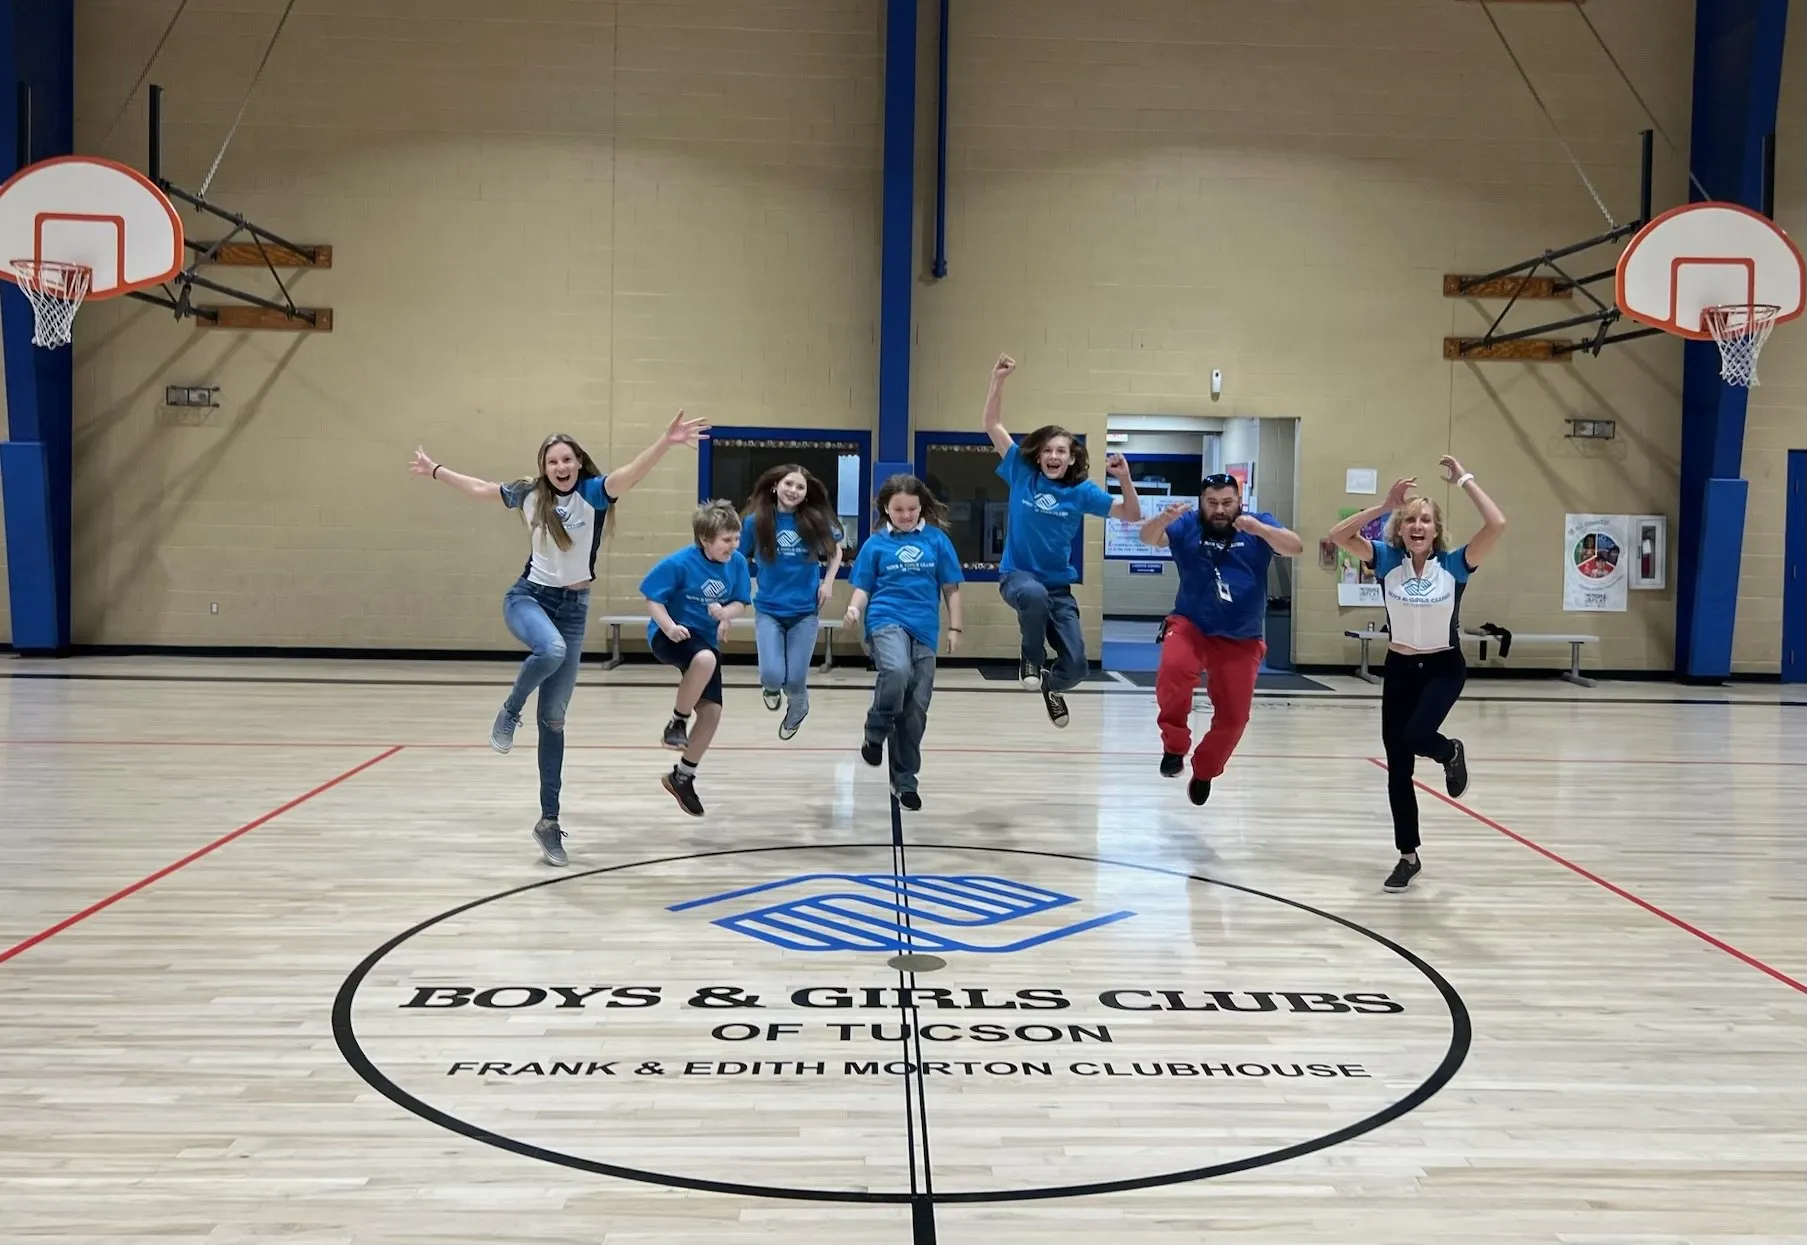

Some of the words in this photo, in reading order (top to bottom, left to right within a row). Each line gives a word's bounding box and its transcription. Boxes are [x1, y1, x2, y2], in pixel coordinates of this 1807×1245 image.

[397, 986, 662, 1009] BOYS
[687, 986, 767, 1009] &
[790, 986, 1071, 1009] GIRLS
[1098, 989, 1405, 1014] CLUBS
[711, 1023, 804, 1041] OF
[826, 1023, 1113, 1042] TUCSON
[446, 1061, 621, 1076] FRANK
[633, 1061, 665, 1076] &
[683, 1061, 825, 1076] EDITH
[844, 1060, 1053, 1076] MORTON
[1068, 1061, 1373, 1078] CLUBHOUSE
